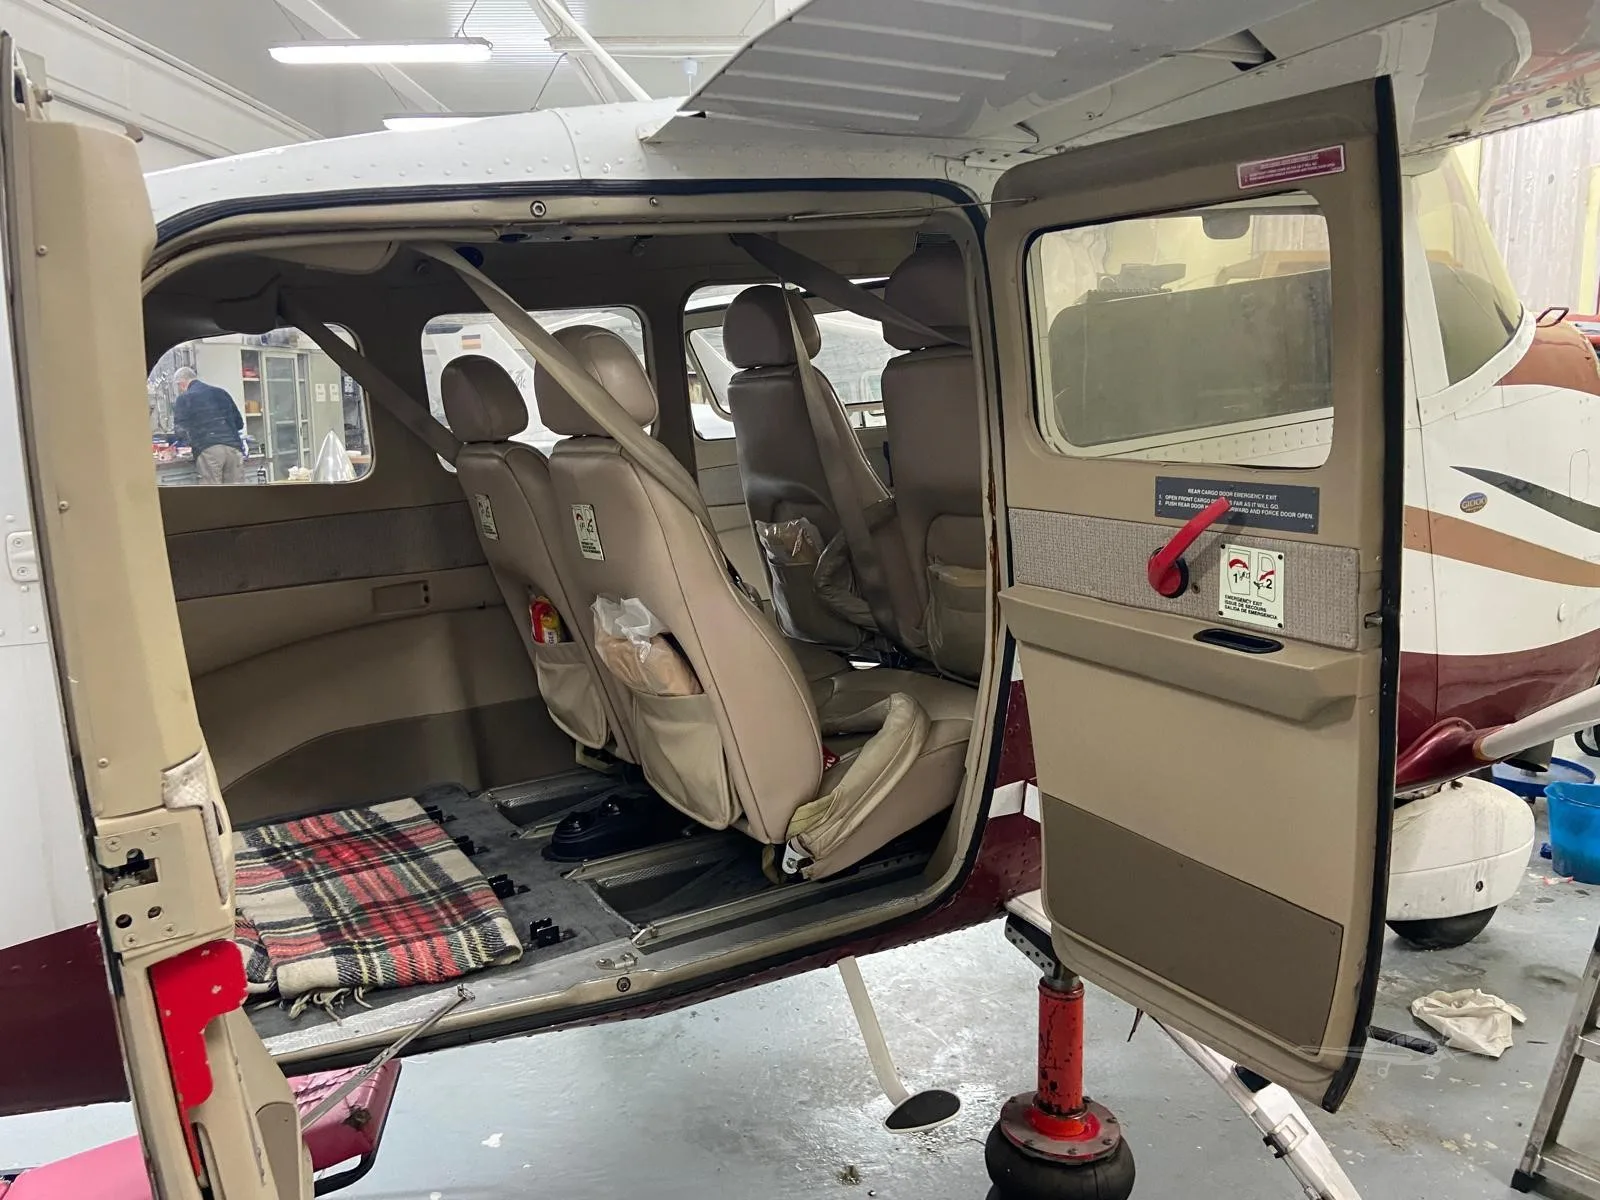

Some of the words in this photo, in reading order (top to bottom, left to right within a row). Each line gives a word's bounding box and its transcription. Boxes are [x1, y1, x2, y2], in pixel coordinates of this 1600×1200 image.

[1233, 573, 1237, 583] 1
[1266, 578, 1272, 589] 2
[1225, 594, 1252, 603] EMERGENCY
[1245, 604, 1266, 612] SECOURS
[1248, 610, 1277, 619] EMERGENCIA
